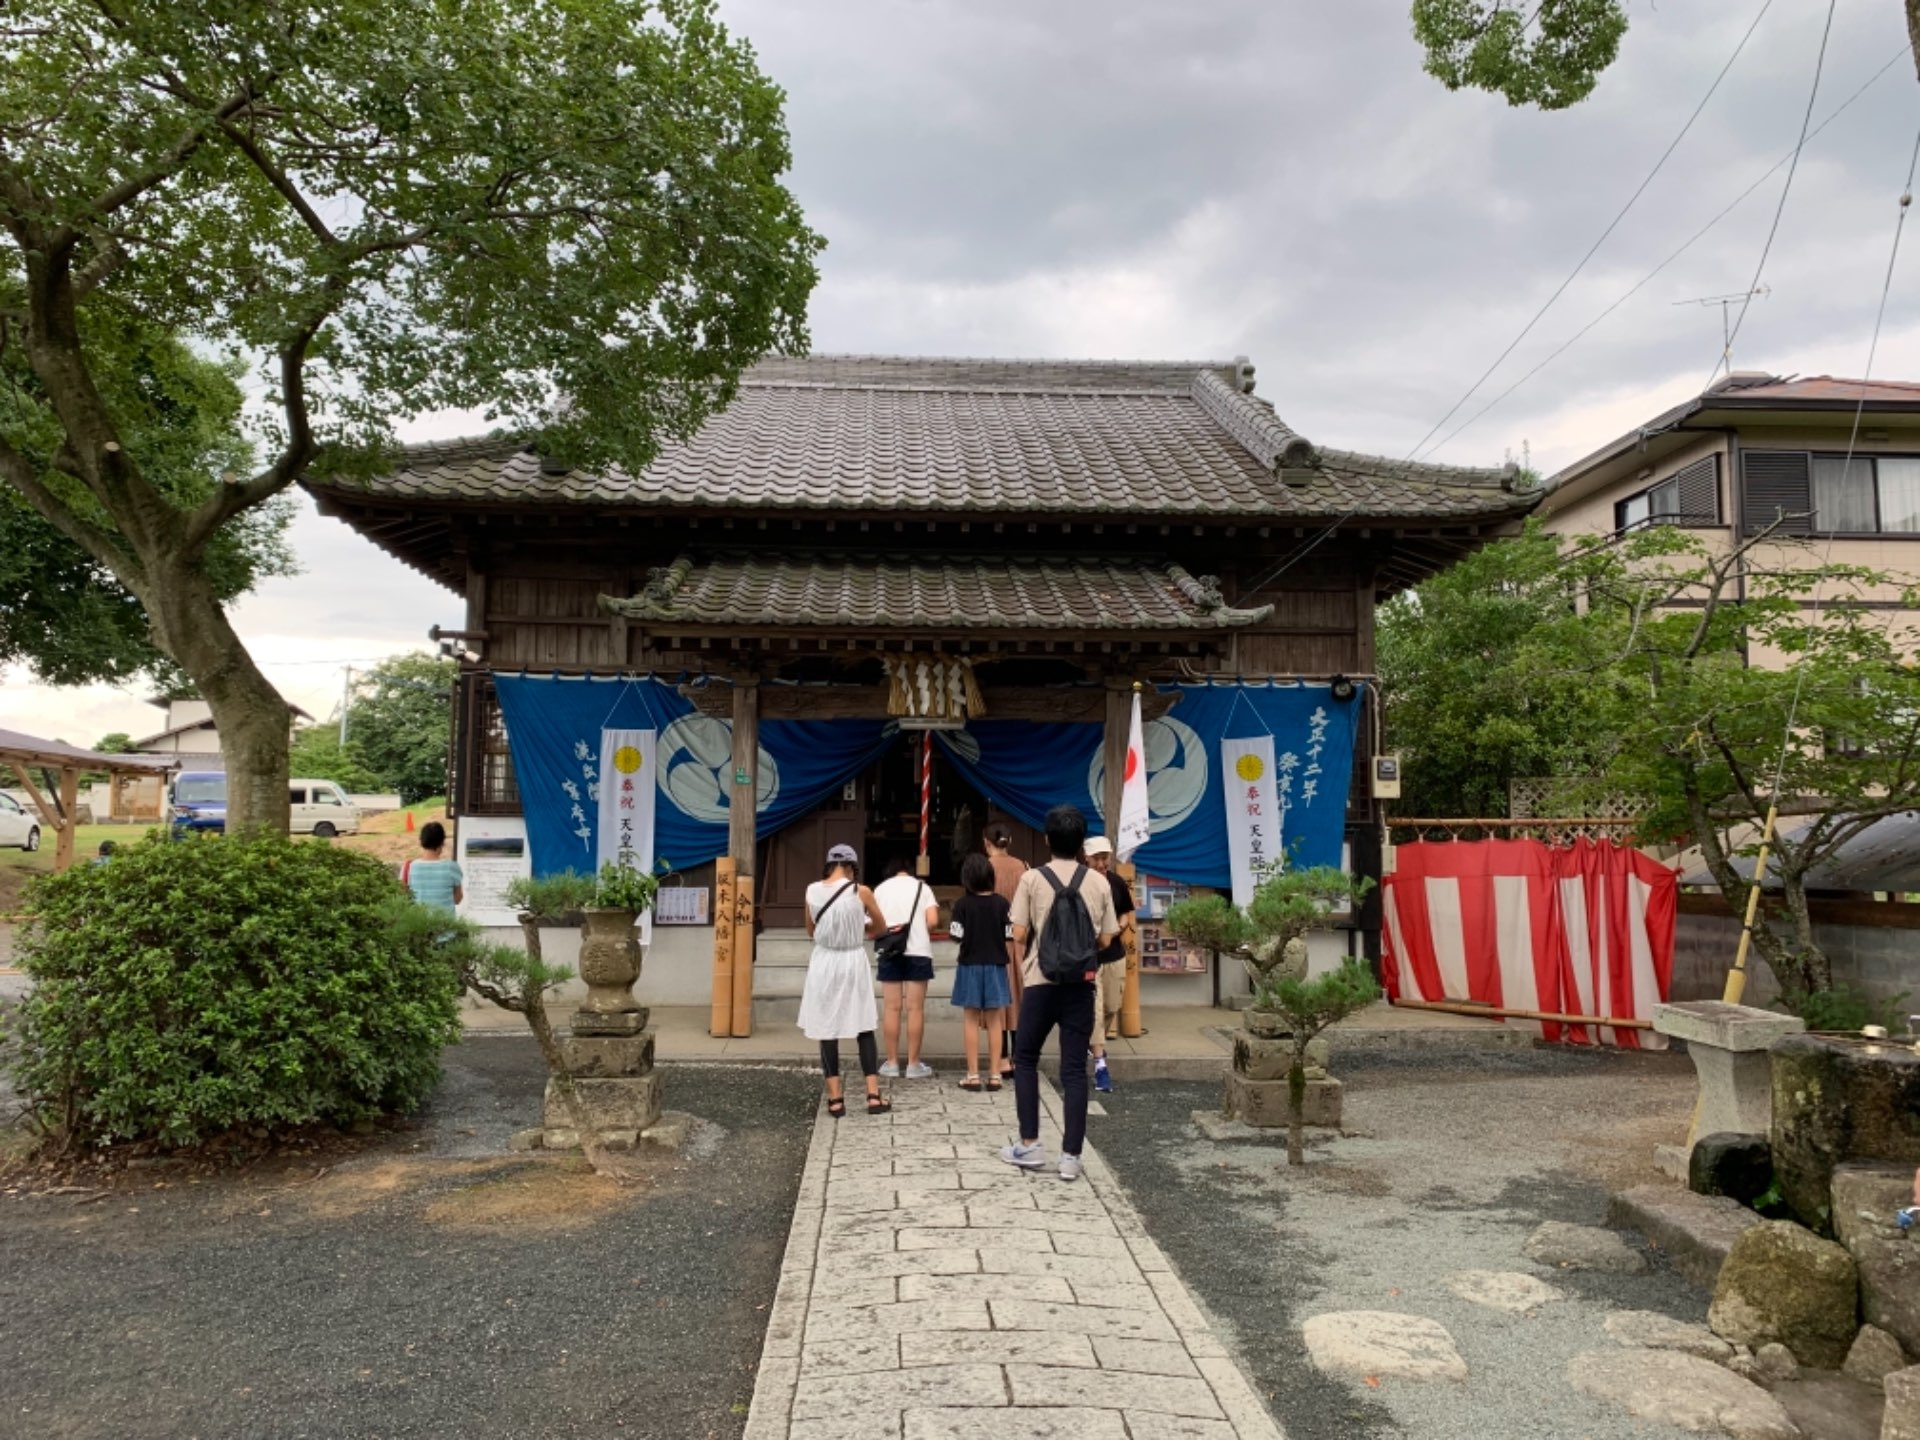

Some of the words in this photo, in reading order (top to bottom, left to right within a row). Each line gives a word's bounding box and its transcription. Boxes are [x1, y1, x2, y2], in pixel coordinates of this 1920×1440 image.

[1300, 705, 1330, 809] 大正十二年
[735, 893, 753, 926] 令和
